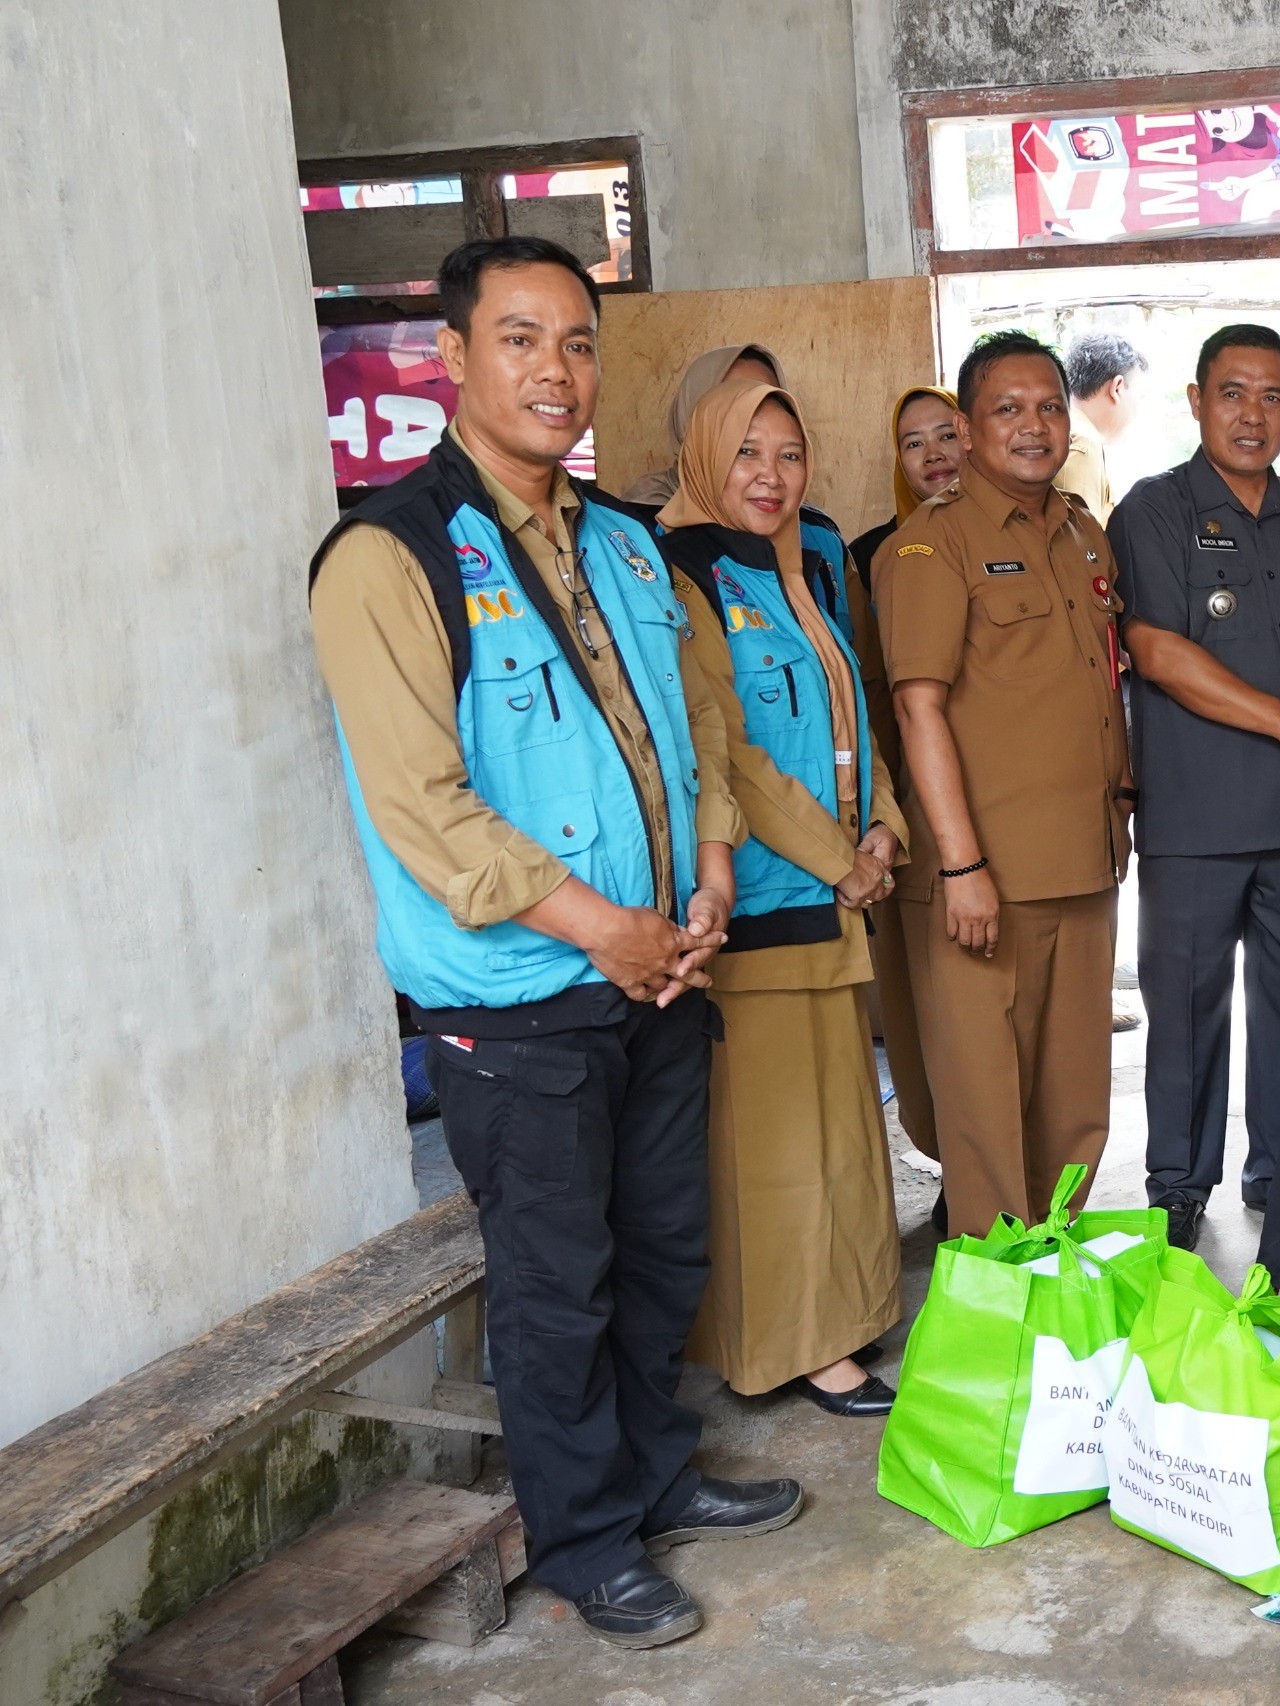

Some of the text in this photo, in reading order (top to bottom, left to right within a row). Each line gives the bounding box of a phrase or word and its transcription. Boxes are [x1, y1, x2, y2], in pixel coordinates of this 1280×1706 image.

[1127, 1458, 1212, 1503] DINAS SOSIAL
[1149, 1446, 1252, 1487] KEDARURATAN
[1118, 1473, 1233, 1538] KABUPATEN KEDIRI
